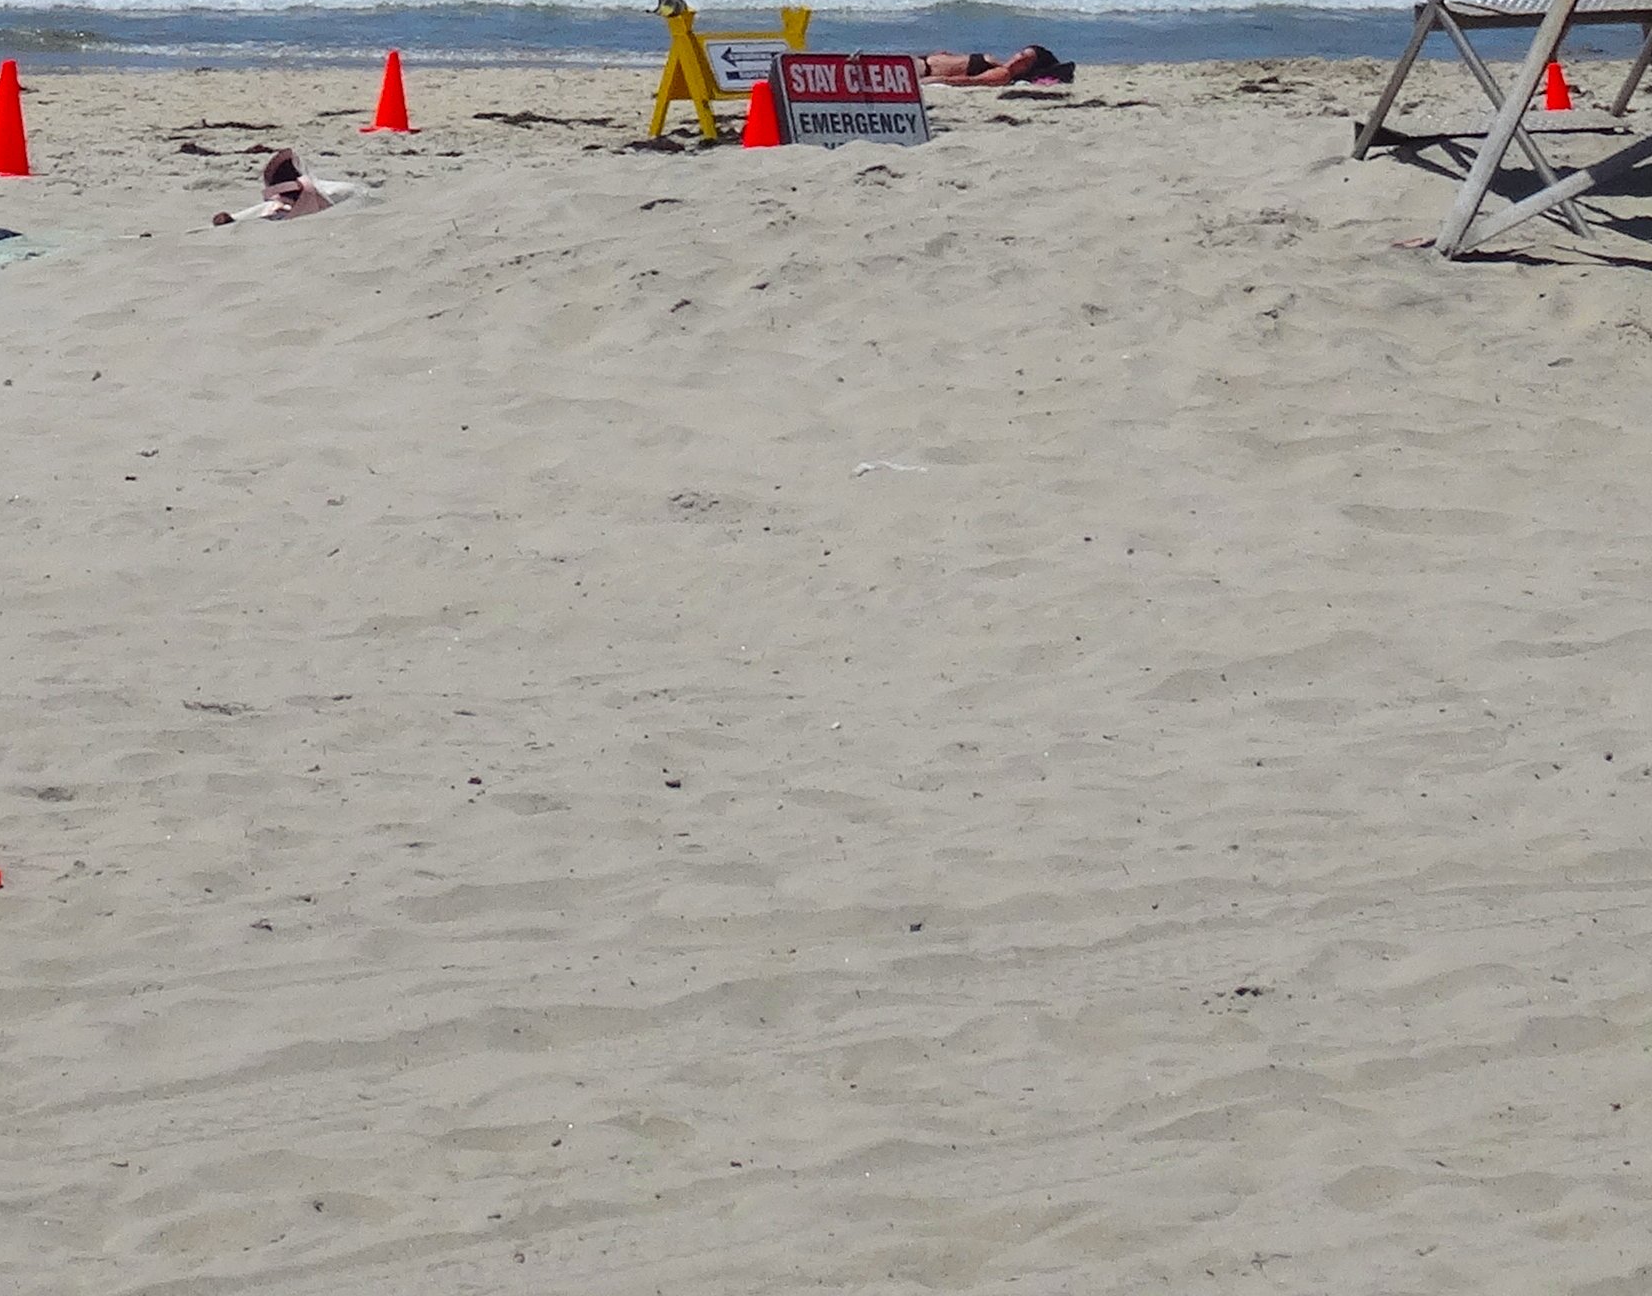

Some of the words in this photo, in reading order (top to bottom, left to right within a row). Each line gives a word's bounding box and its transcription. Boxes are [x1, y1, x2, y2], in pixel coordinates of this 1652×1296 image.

[790, 63, 836, 93] STAY
[844, 64, 912, 94] CLEAR
[799, 113, 917, 134] EMERGENCY
